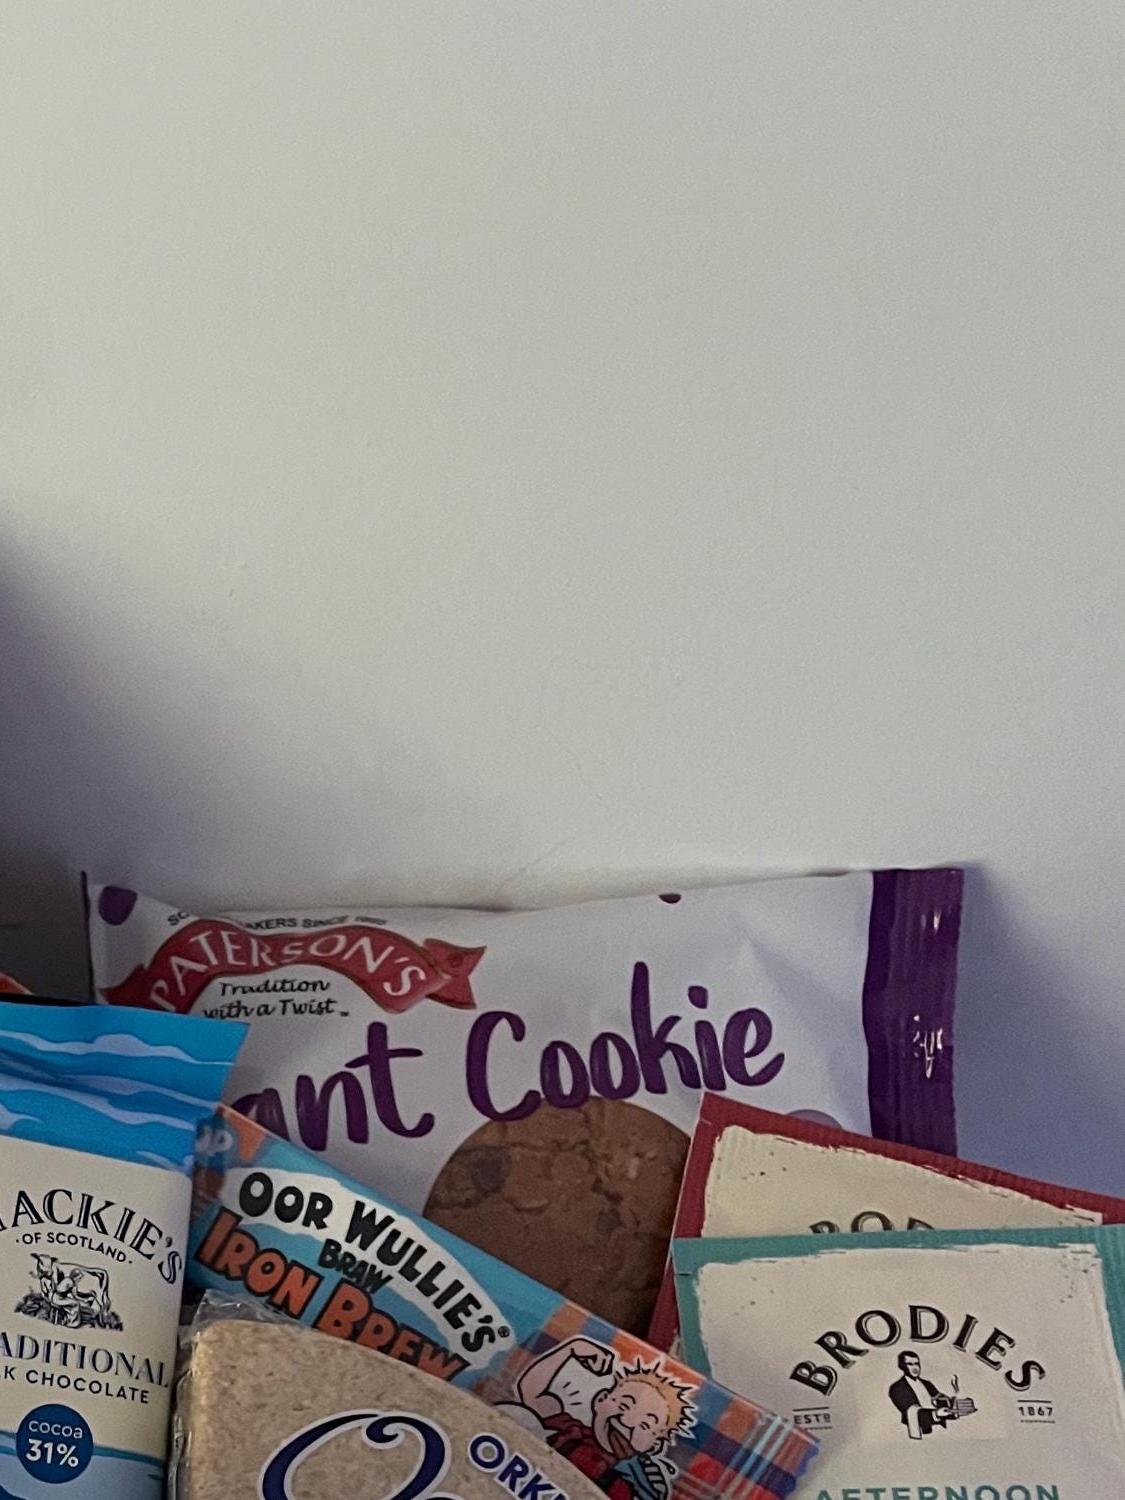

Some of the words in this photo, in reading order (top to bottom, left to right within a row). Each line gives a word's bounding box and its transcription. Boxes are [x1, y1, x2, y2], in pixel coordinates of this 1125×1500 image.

[245, 918, 298, 930] AKERS
[149, 931, 426, 1011] PATERSON'S
[218, 979, 332, 998] Tradition
[203, 1000, 253, 1020] with
[255, 1004, 275, 1017] a
[279, 1000, 338, 1017] Twist
[226, 1022, 434, 1152] ant
[466, 961, 786, 1125] Cookie
[21, 1231, 42, 1246] OF
[46, 1232, 128, 1264] SCOTLAND
[239, 1172, 334, 1230] OOR
[344, 1200, 497, 1353] WULLIE'S
[318, 1238, 394, 1295] BRAW
[194, 1206, 324, 1320] IRON
[314, 1278, 471, 1381] BREW
[789, 1303, 1047, 1397] BRODIES
[25, 1368, 150, 1406] CHOCOLATE
[1018, 1406, 1054, 1418] 1867
[26, 1439, 80, 1468] 31%
